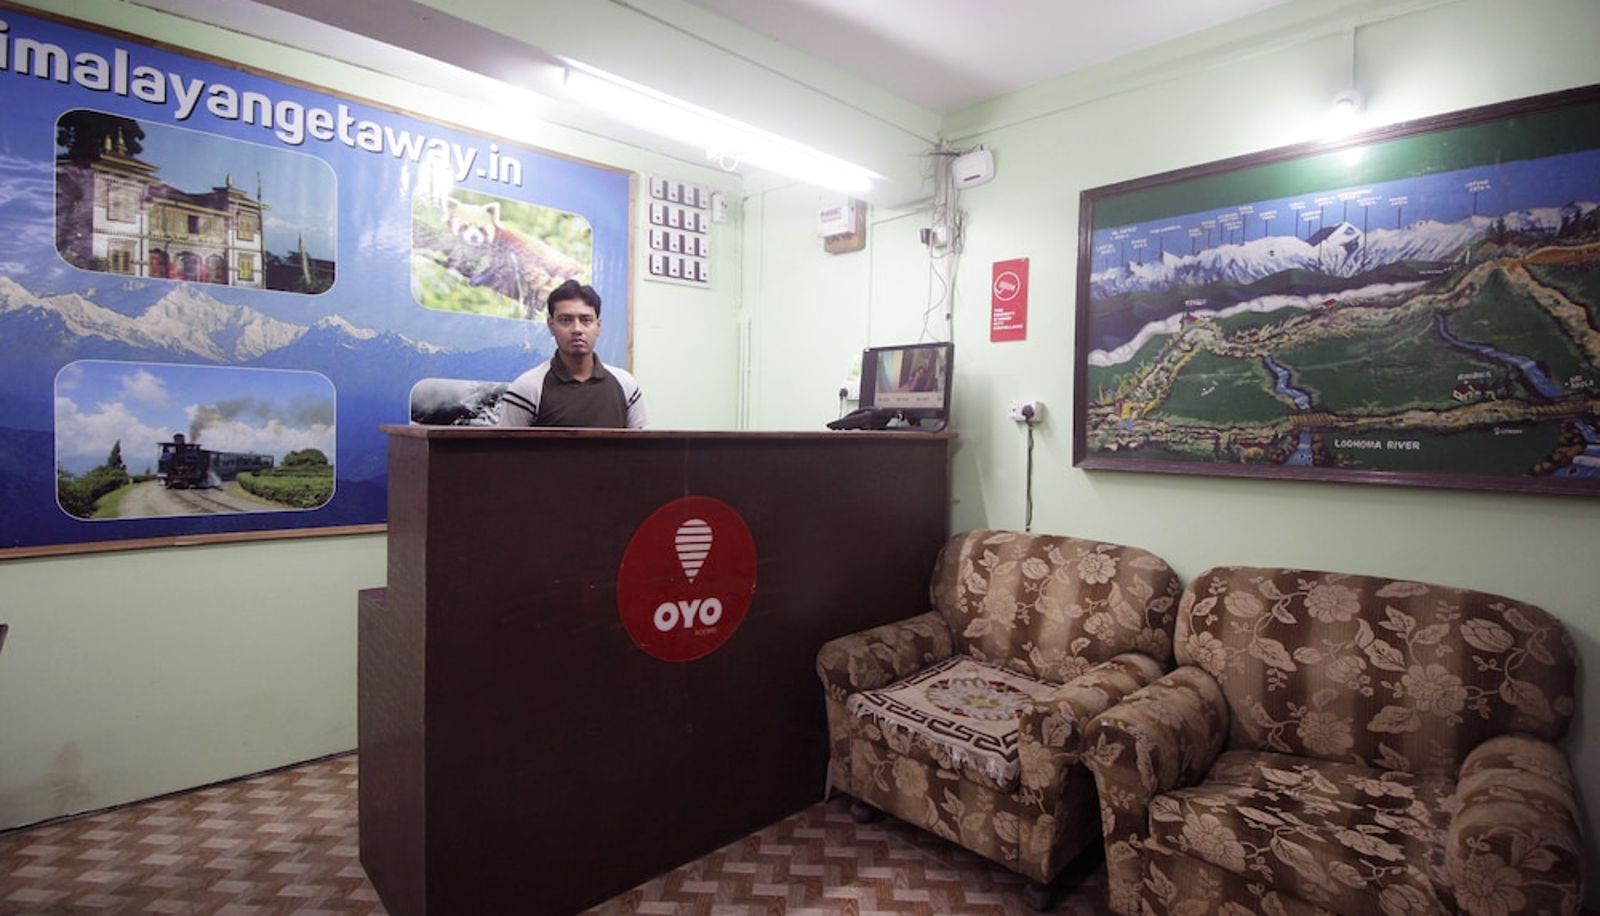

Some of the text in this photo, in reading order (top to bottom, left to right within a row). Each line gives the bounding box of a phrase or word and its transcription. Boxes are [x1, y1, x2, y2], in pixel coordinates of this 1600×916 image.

[0, 20, 523, 187] imalayangetaway.in
[1386, 440, 1421, 450] RIVER
[654, 597, 723, 632] OYO
